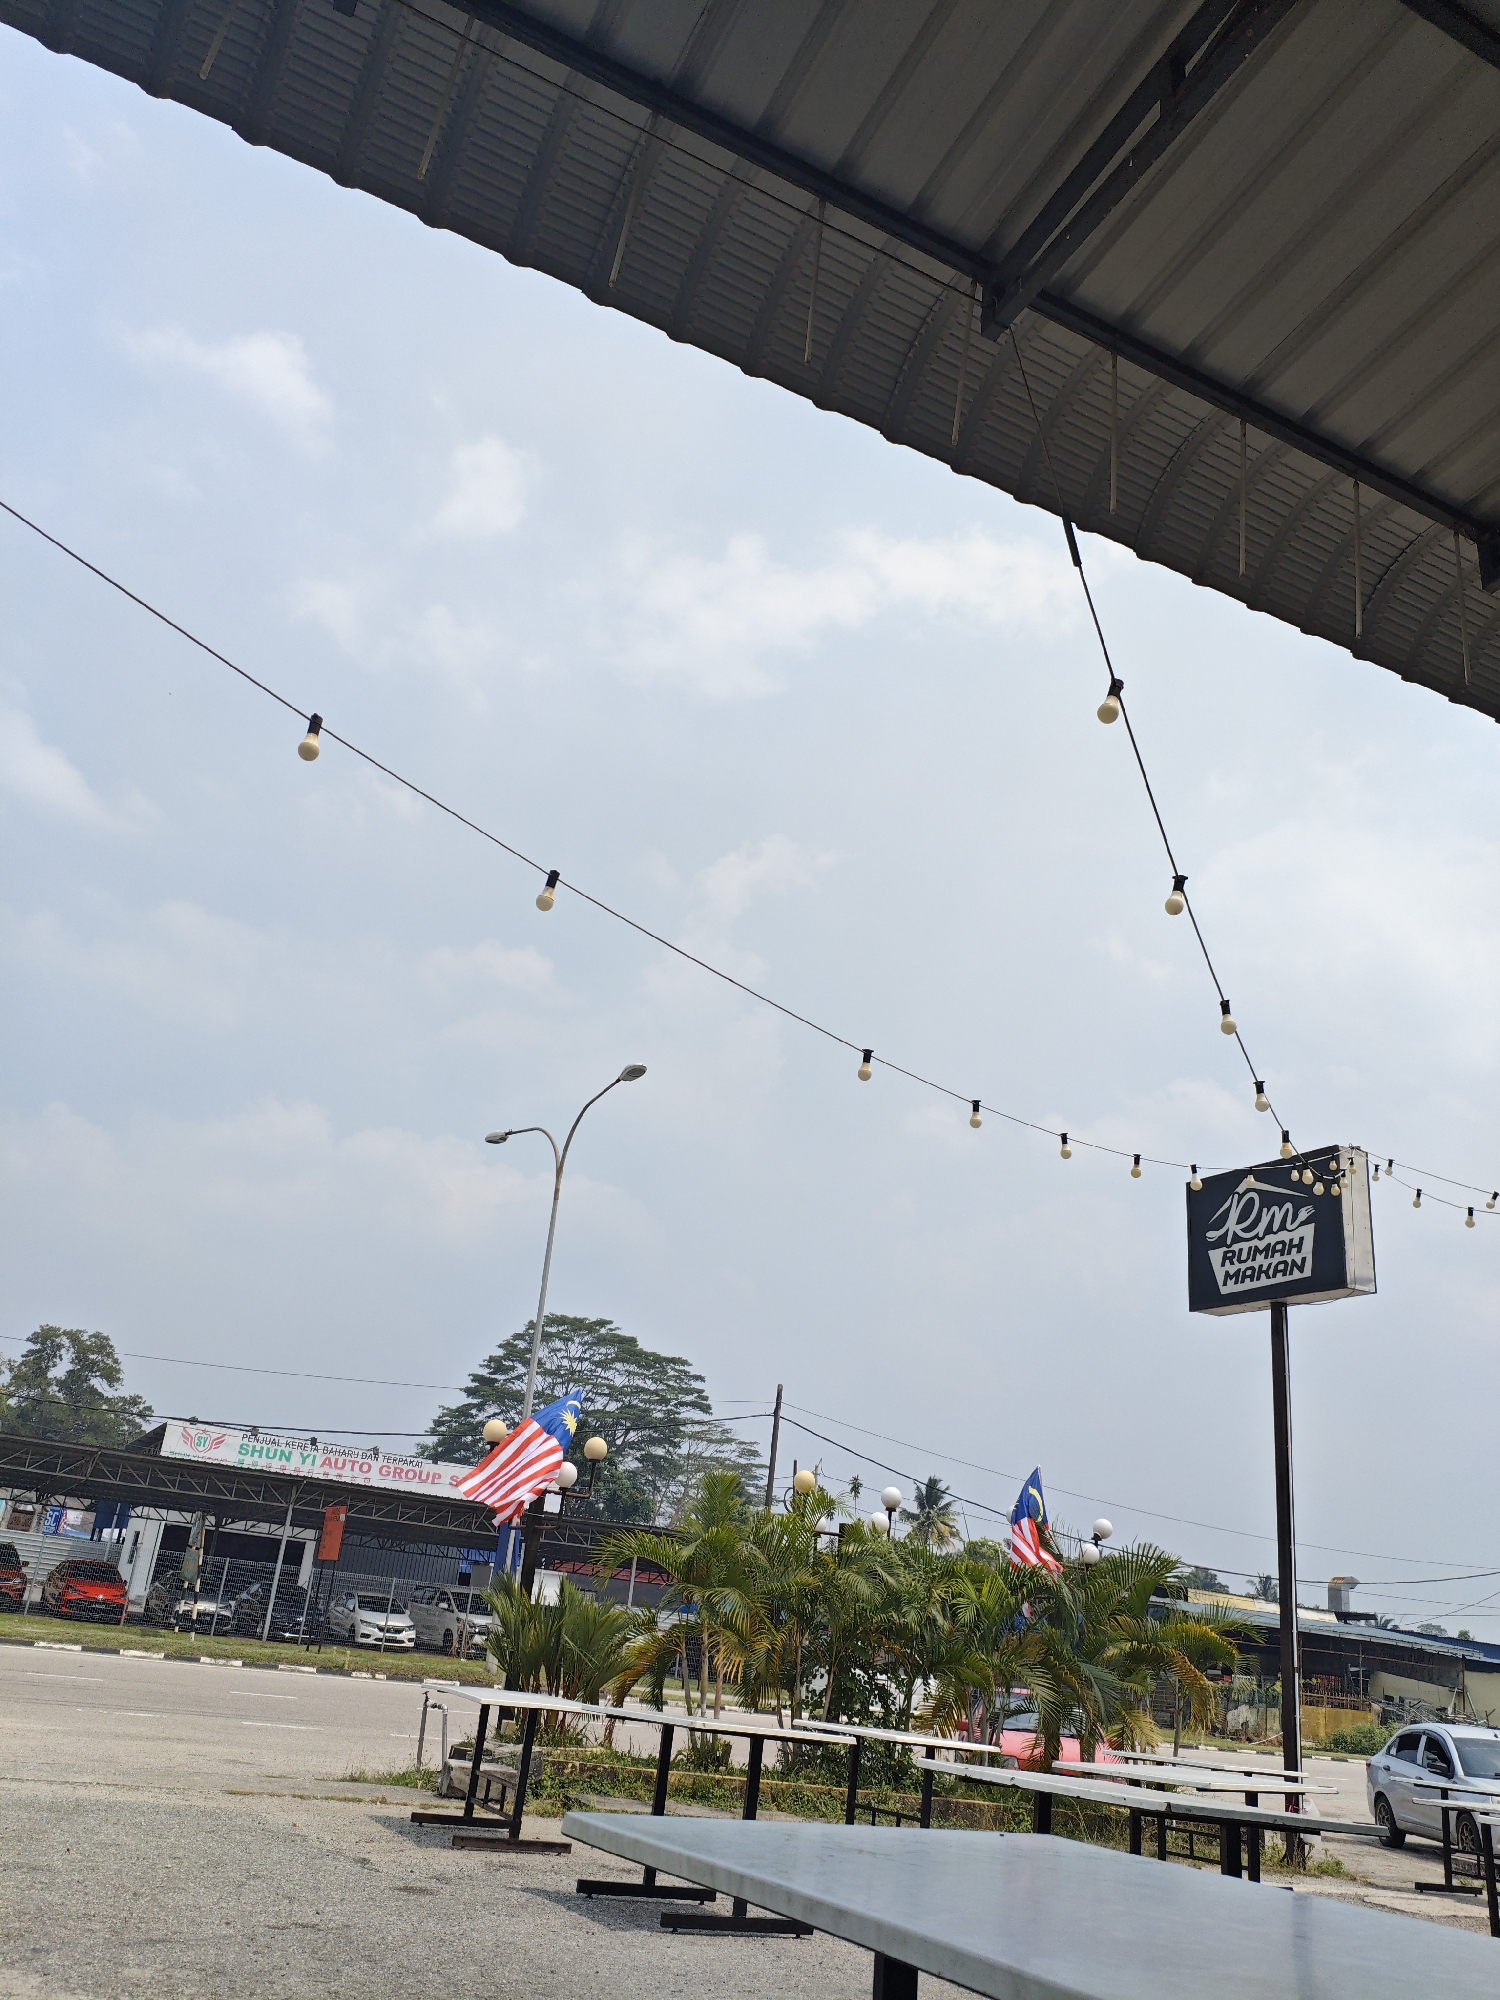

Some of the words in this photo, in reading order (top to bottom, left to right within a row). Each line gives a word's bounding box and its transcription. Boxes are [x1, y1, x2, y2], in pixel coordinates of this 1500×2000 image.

[1220, 1236, 1304, 1268] RUMAH
[1222, 1256, 1307, 1287] MAKAN
[196, 1435, 209, 1448] SY
[241, 1433, 282, 1447] PENJUAL
[284, 1440, 319, 1453] KERETA
[322, 1445, 359, 1459] BAHARU
[382, 1455, 424, 1468] TERPAKAI
[238, 1443, 293, 1462] SHUN
[299, 1451, 317, 1467] YI
[320, 1456, 372, 1474] AUTO
[378, 1465, 442, 1483] GROUP
